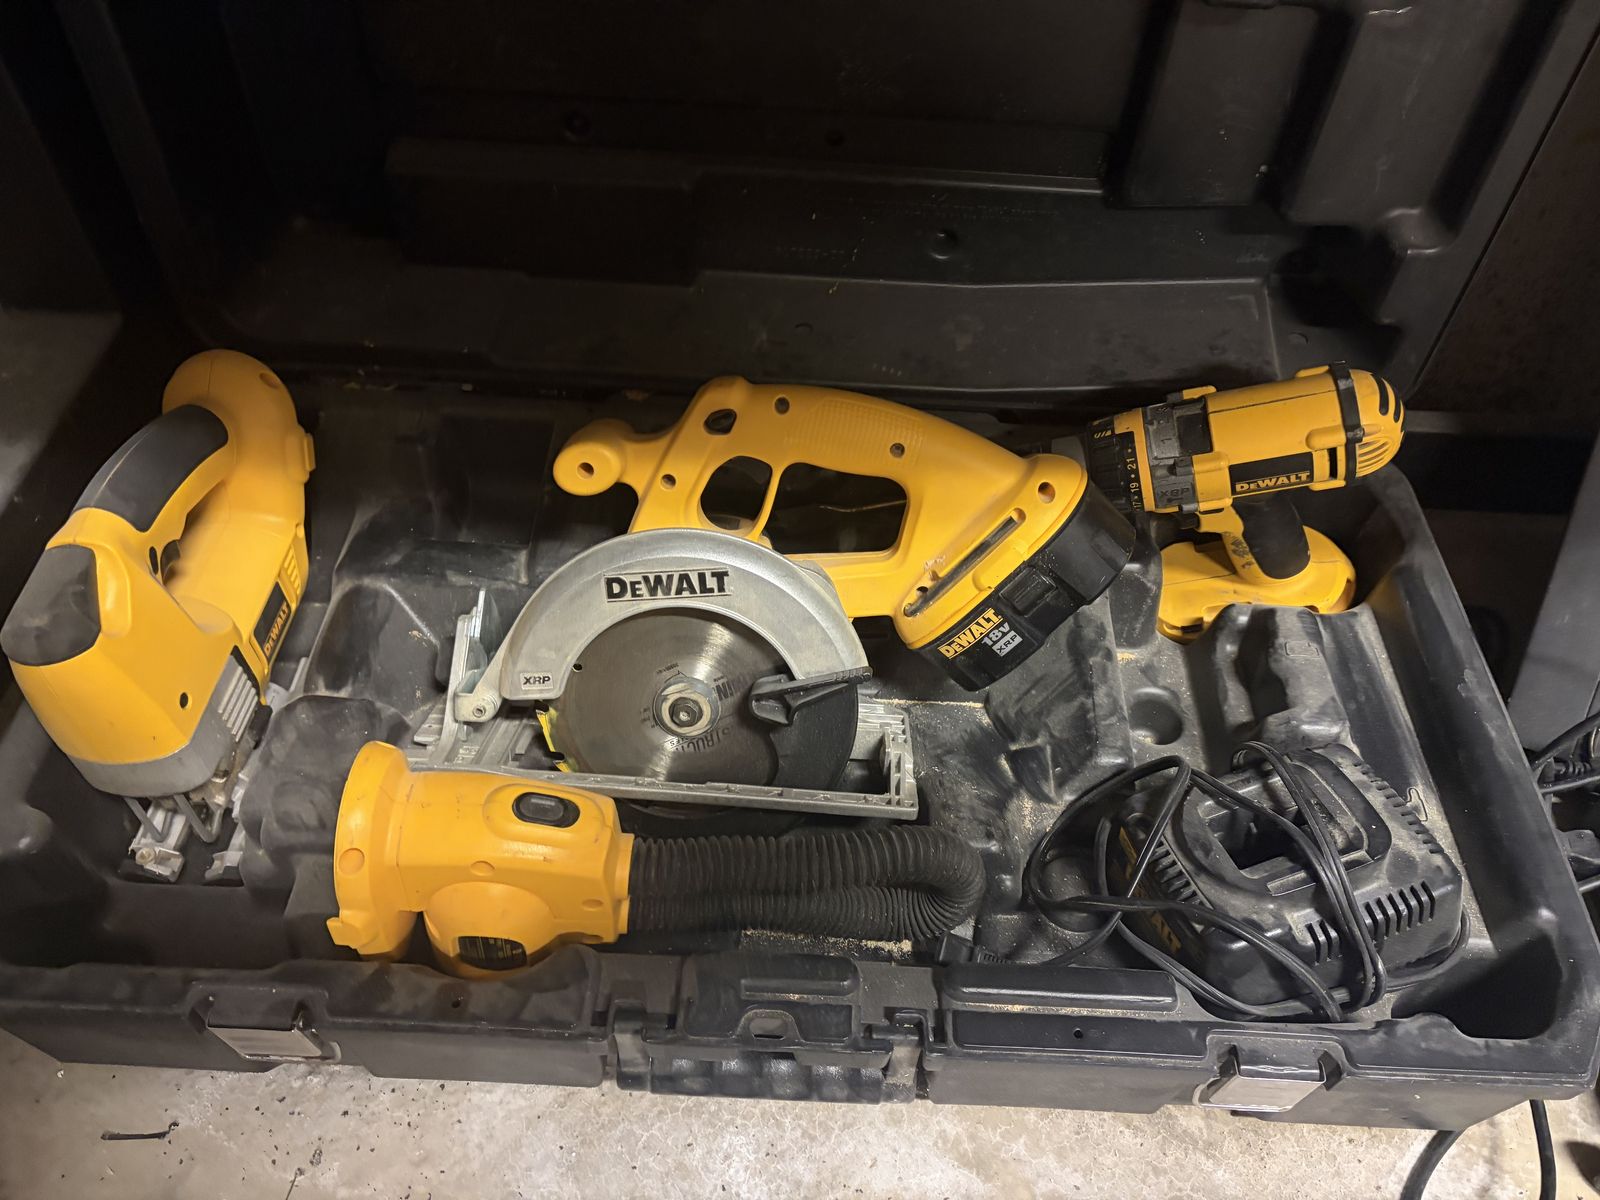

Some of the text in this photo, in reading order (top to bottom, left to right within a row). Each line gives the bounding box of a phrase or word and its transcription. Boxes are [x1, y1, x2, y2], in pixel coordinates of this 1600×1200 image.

[1126, 457, 1136, 471] 21
[1129, 482, 1139, 493] 19
[1235, 472, 1310, 493] DEWALT
[605, 570, 730, 600] DEWALT
[263, 601, 289, 657] DEWALT
[938, 608, 1001, 658] DEWALT
[994, 633, 1018, 654] XRP
[522, 674, 552, 688] XRP
